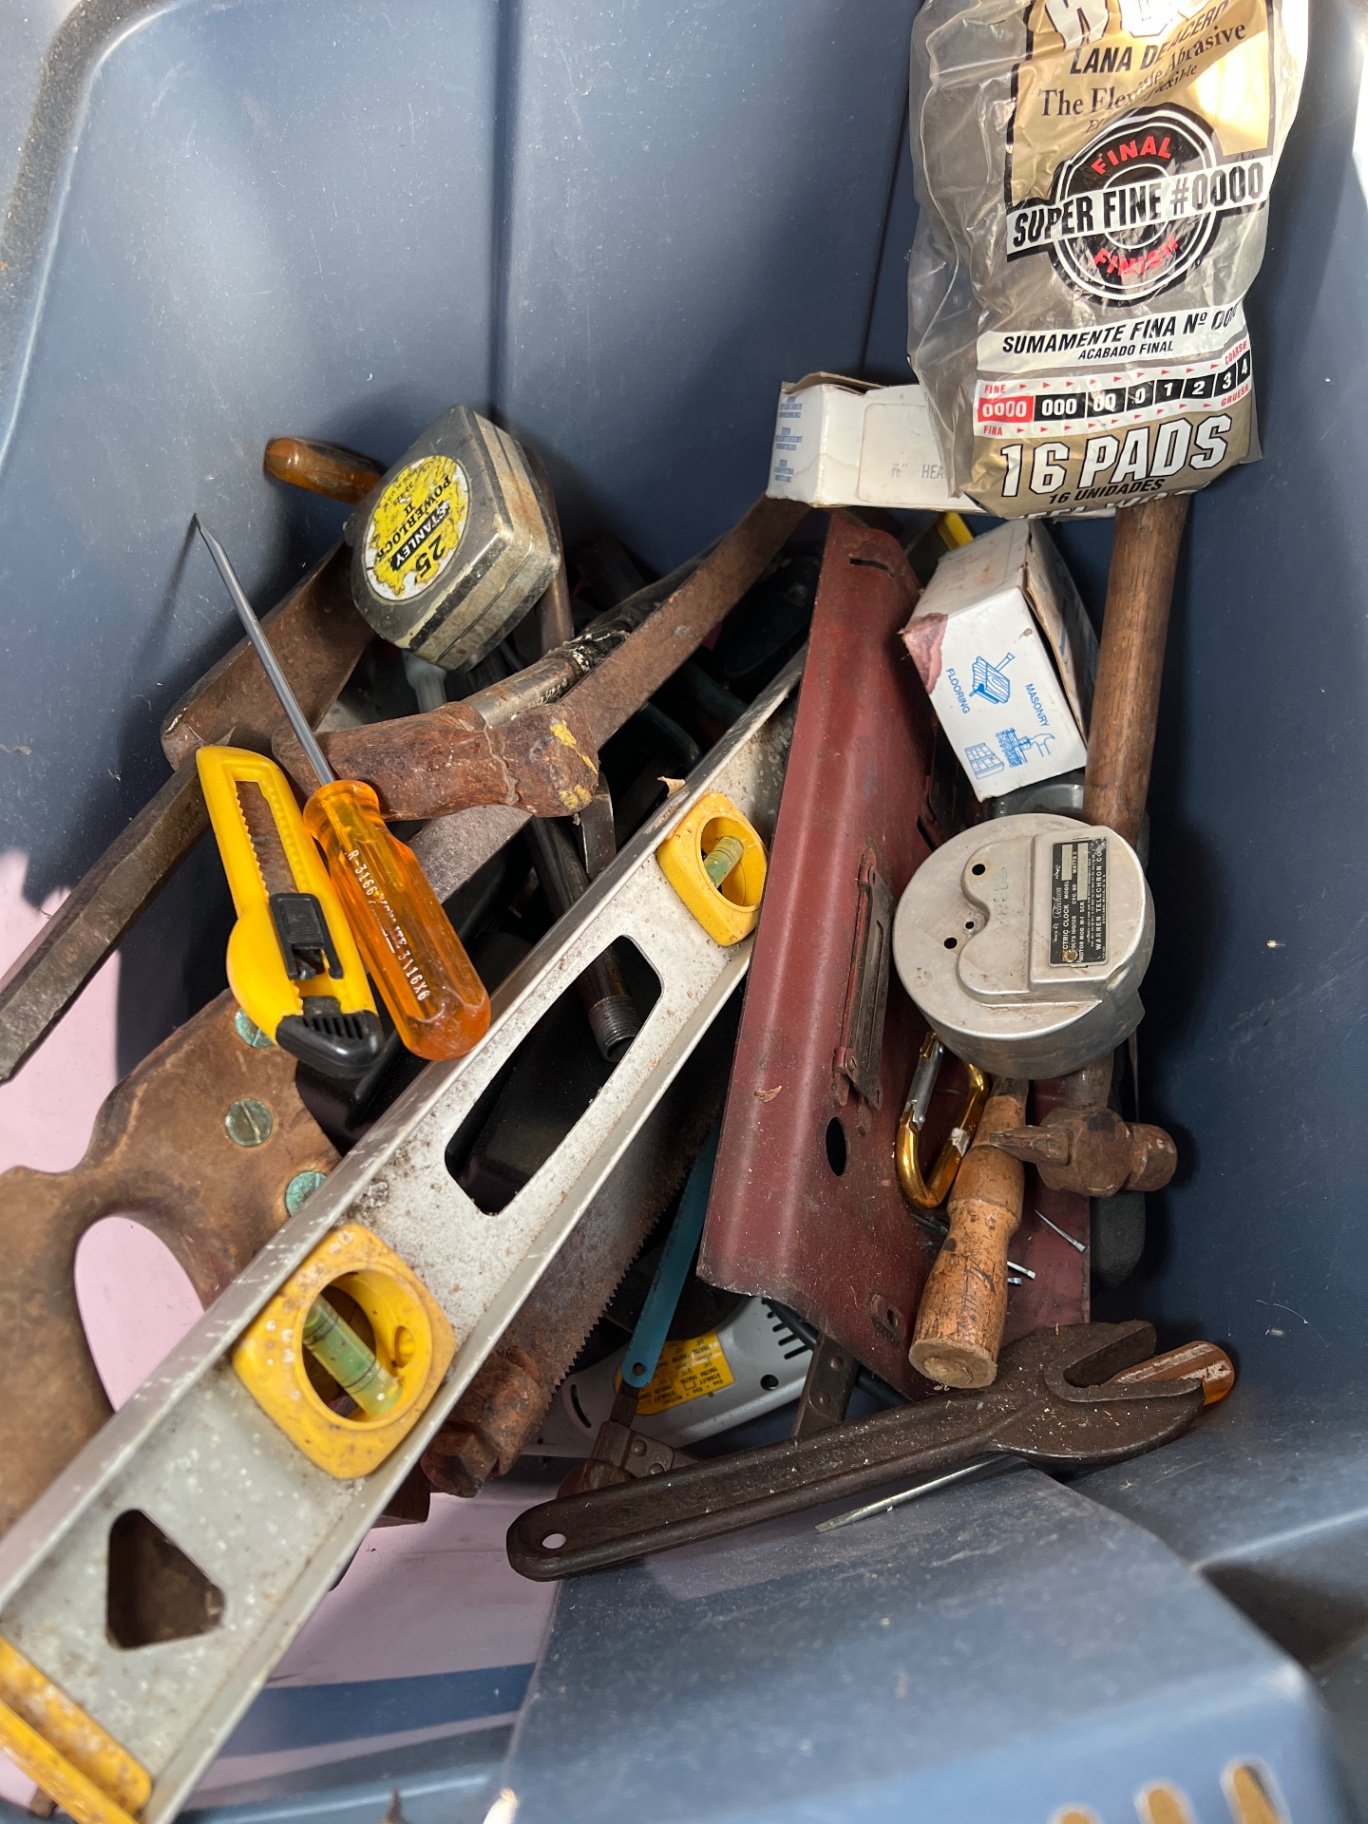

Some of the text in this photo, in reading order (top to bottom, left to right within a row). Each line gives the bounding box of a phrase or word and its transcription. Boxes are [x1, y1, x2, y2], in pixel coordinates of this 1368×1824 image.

[1070, 47, 1132, 75] LANA
[1039, 89, 1084, 116] The
[1091, 135, 1173, 176] FINAL
[1012, 162, 1264, 248] SUPER FINE #0000
[1093, 235, 1179, 276] FINISH
[1002, 324, 1127, 354] SUMAMENTE
[1130, 315, 1176, 343] FINA
[1077, 340, 1174, 361] ACABADO FINAL
[982, 400, 1027, 418] 0000
[1041, 397, 1078, 416] 000
[1092, 392, 1117, 412] 00
[1163, 379, 1174, 397] 1
[1191, 380, 1205, 395] 2
[1221, 371, 1233, 391] 3
[1240, 358, 1249, 377] 4
[984, 340, 1248, 395] FINE COARSE
[983, 425, 1004, 436] FINA
[1001, 413, 1233, 498] 16 PADS
[1049, 491, 1070, 505] 16
[1073, 478, 1166, 502] UNIDADES
[376, 475, 452, 562] POWERLOCK
[397, 501, 450, 567] STANLEY
[946, 668, 971, 714] FLOORING
[1025, 683, 1049, 727] MASONRY
[346, 849, 378, 896] R-3166
